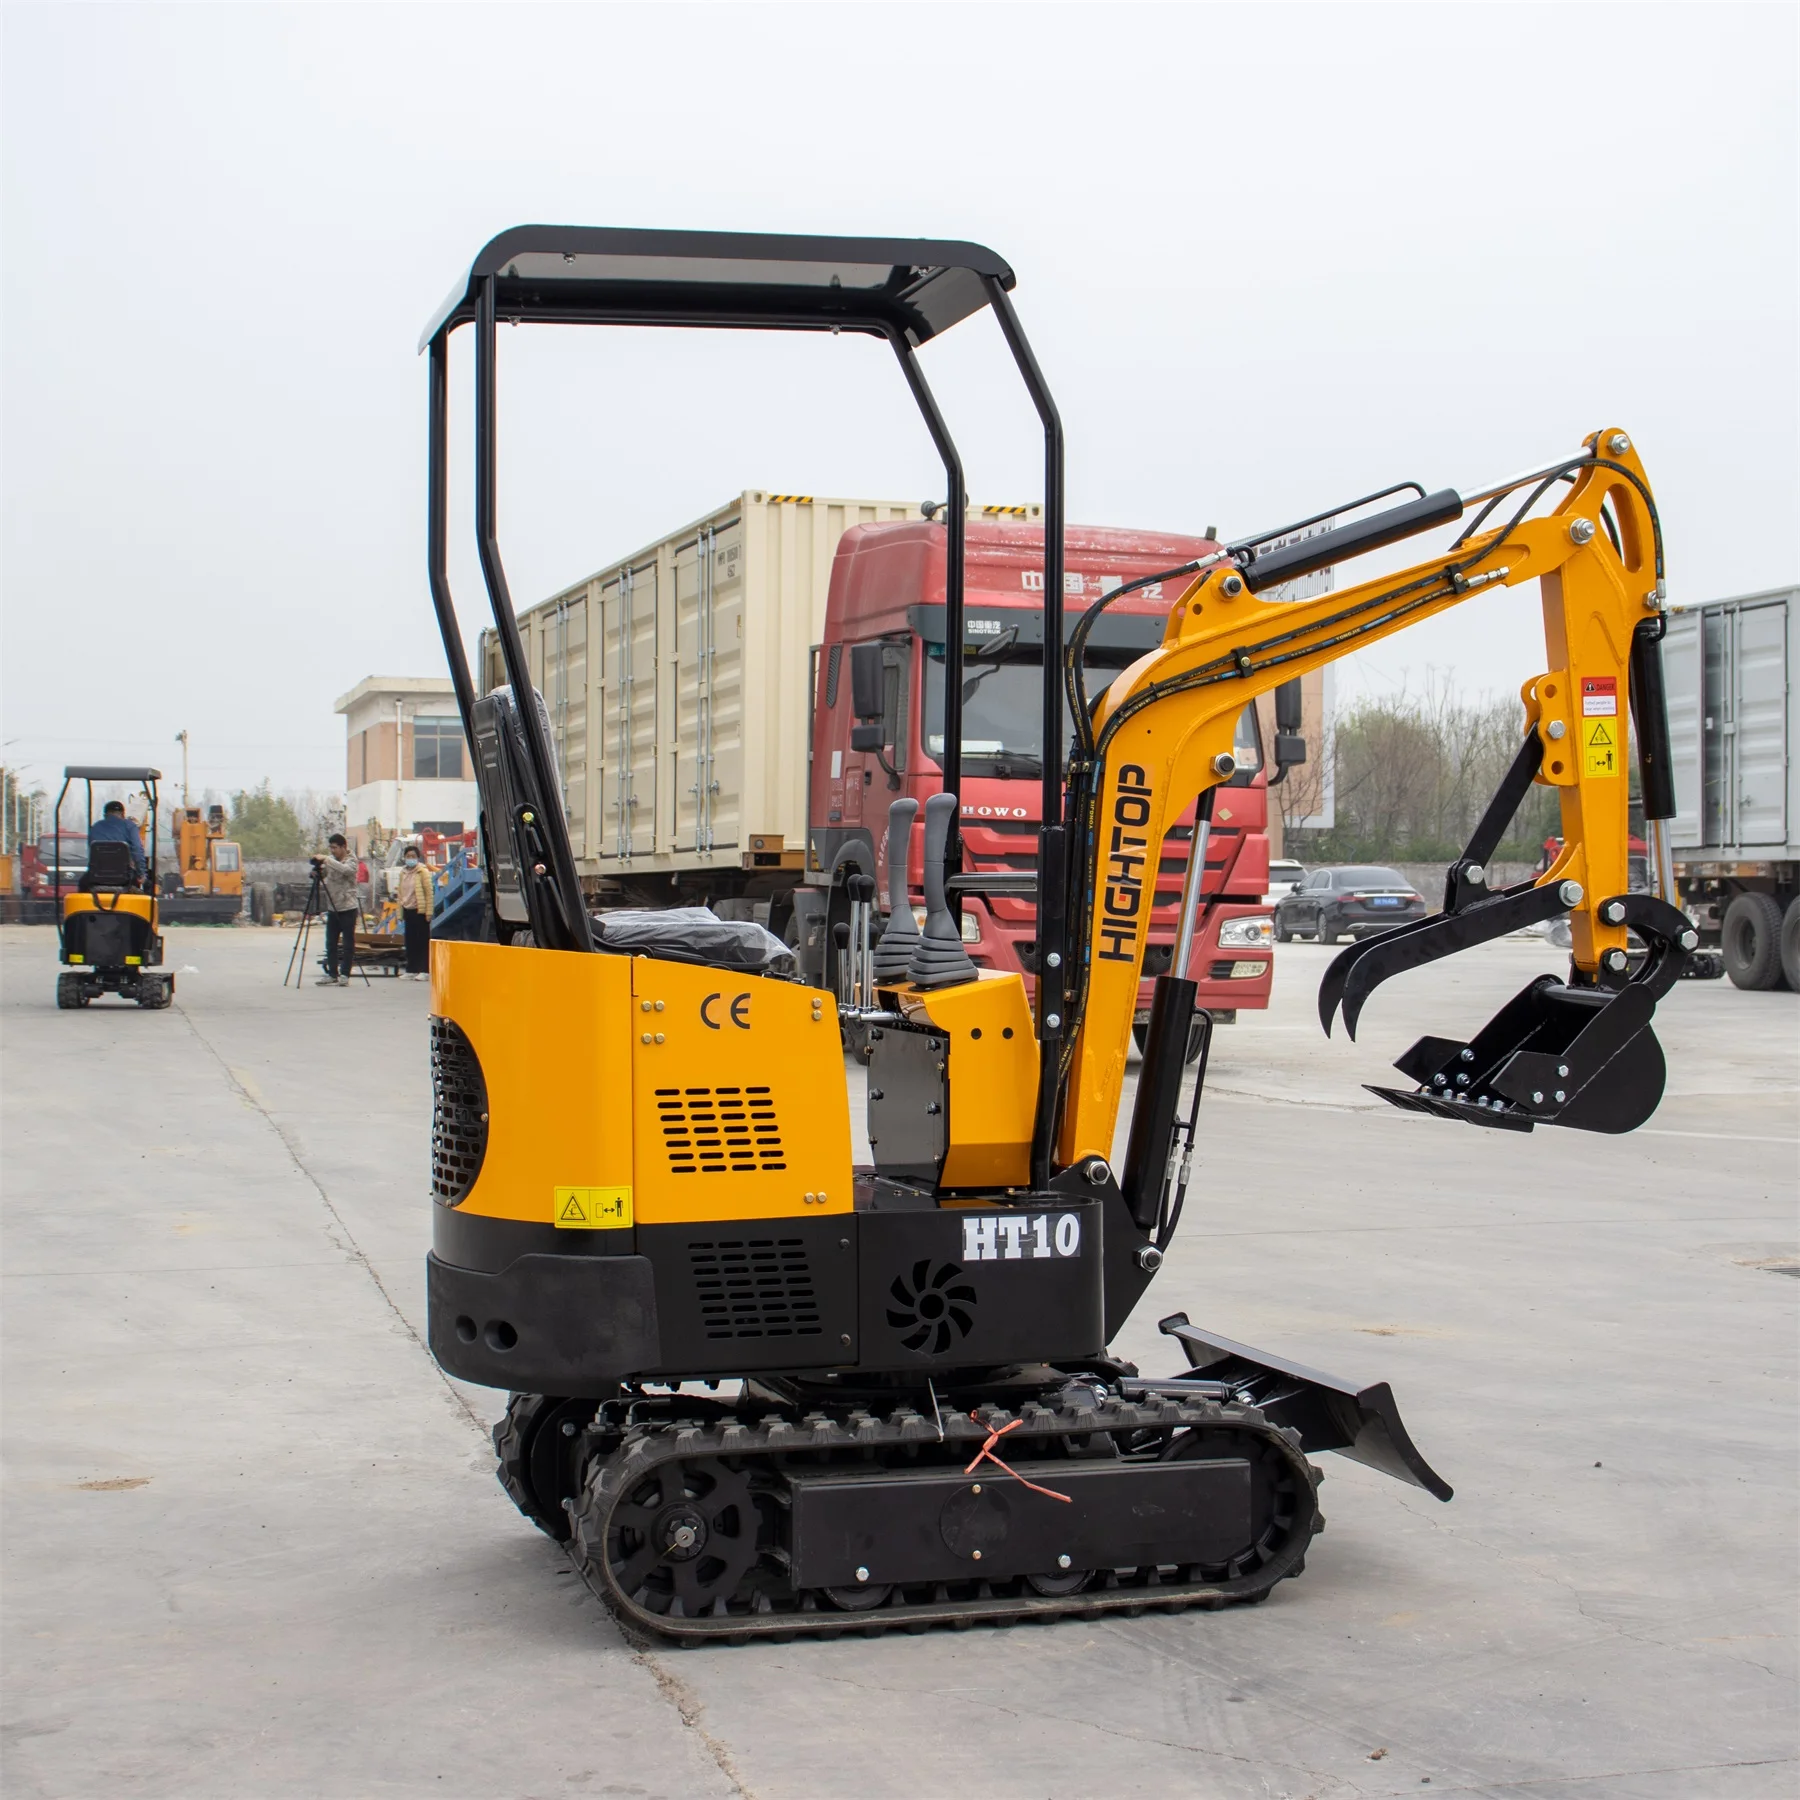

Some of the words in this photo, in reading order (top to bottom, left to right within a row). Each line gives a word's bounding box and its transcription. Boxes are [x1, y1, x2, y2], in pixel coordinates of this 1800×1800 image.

[961, 805, 1027, 818] HOWO
[1098, 764, 1152, 962] HIGHTOP
[700, 992, 751, 1030] CE
[963, 1213, 1080, 1261] HT10
